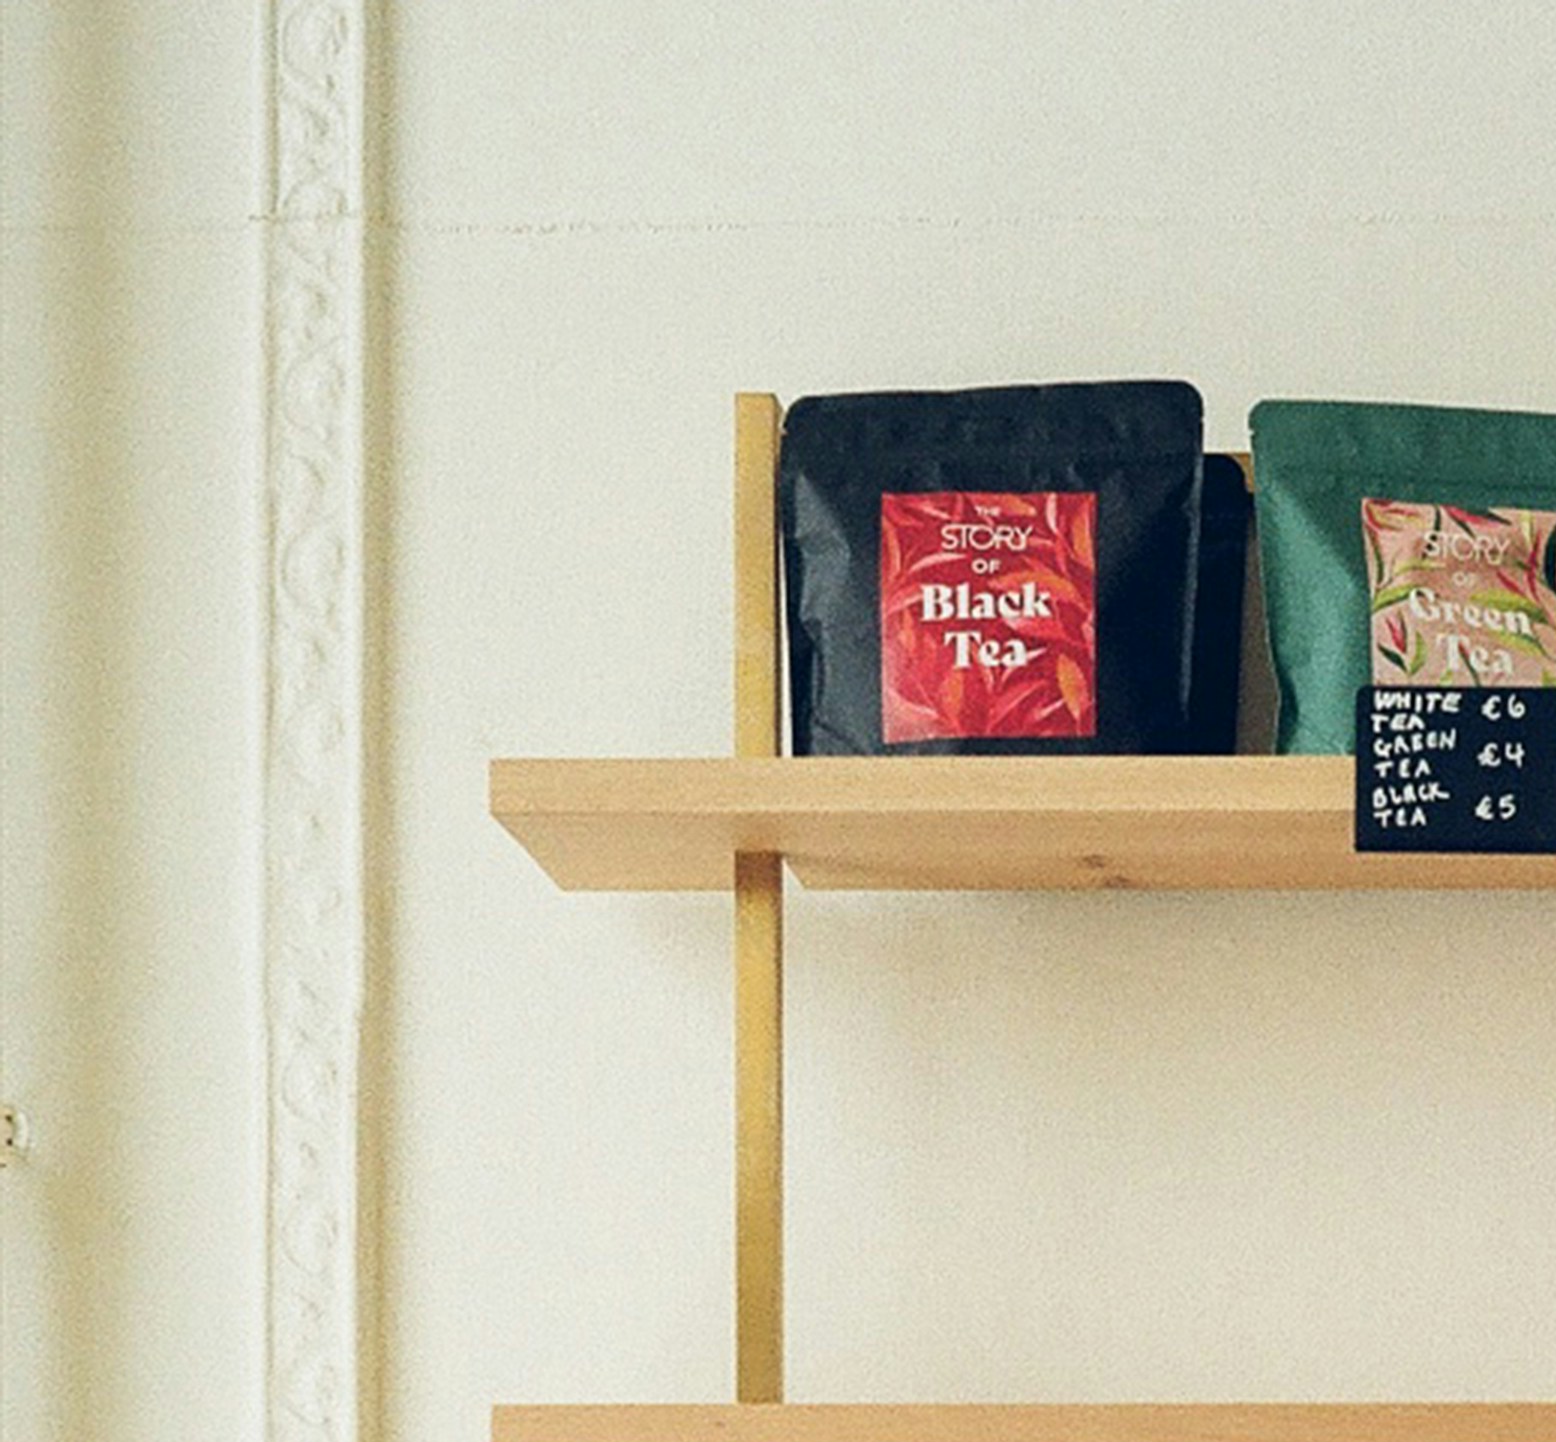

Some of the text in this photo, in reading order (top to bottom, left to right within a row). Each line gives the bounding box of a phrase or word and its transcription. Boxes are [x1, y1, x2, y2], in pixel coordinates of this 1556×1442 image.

[940, 523, 1033, 551] STORY
[1422, 529, 1511, 565] STORY
[971, 558, 1000, 575] OF
[920, 581, 1053, 622] Black
[1408, 587, 1533, 636] Green
[943, 630, 1028, 668] Tea
[1434, 632, 1514, 675] Tea
[1373, 690, 1462, 713] WHITE
[1370, 714, 1426, 733] TEA
[1373, 728, 1457, 758] GREEN
[1374, 758, 1432, 779] TEA
[1372, 782, 1450, 810] BLACK
[1373, 807, 1427, 828] TEA
